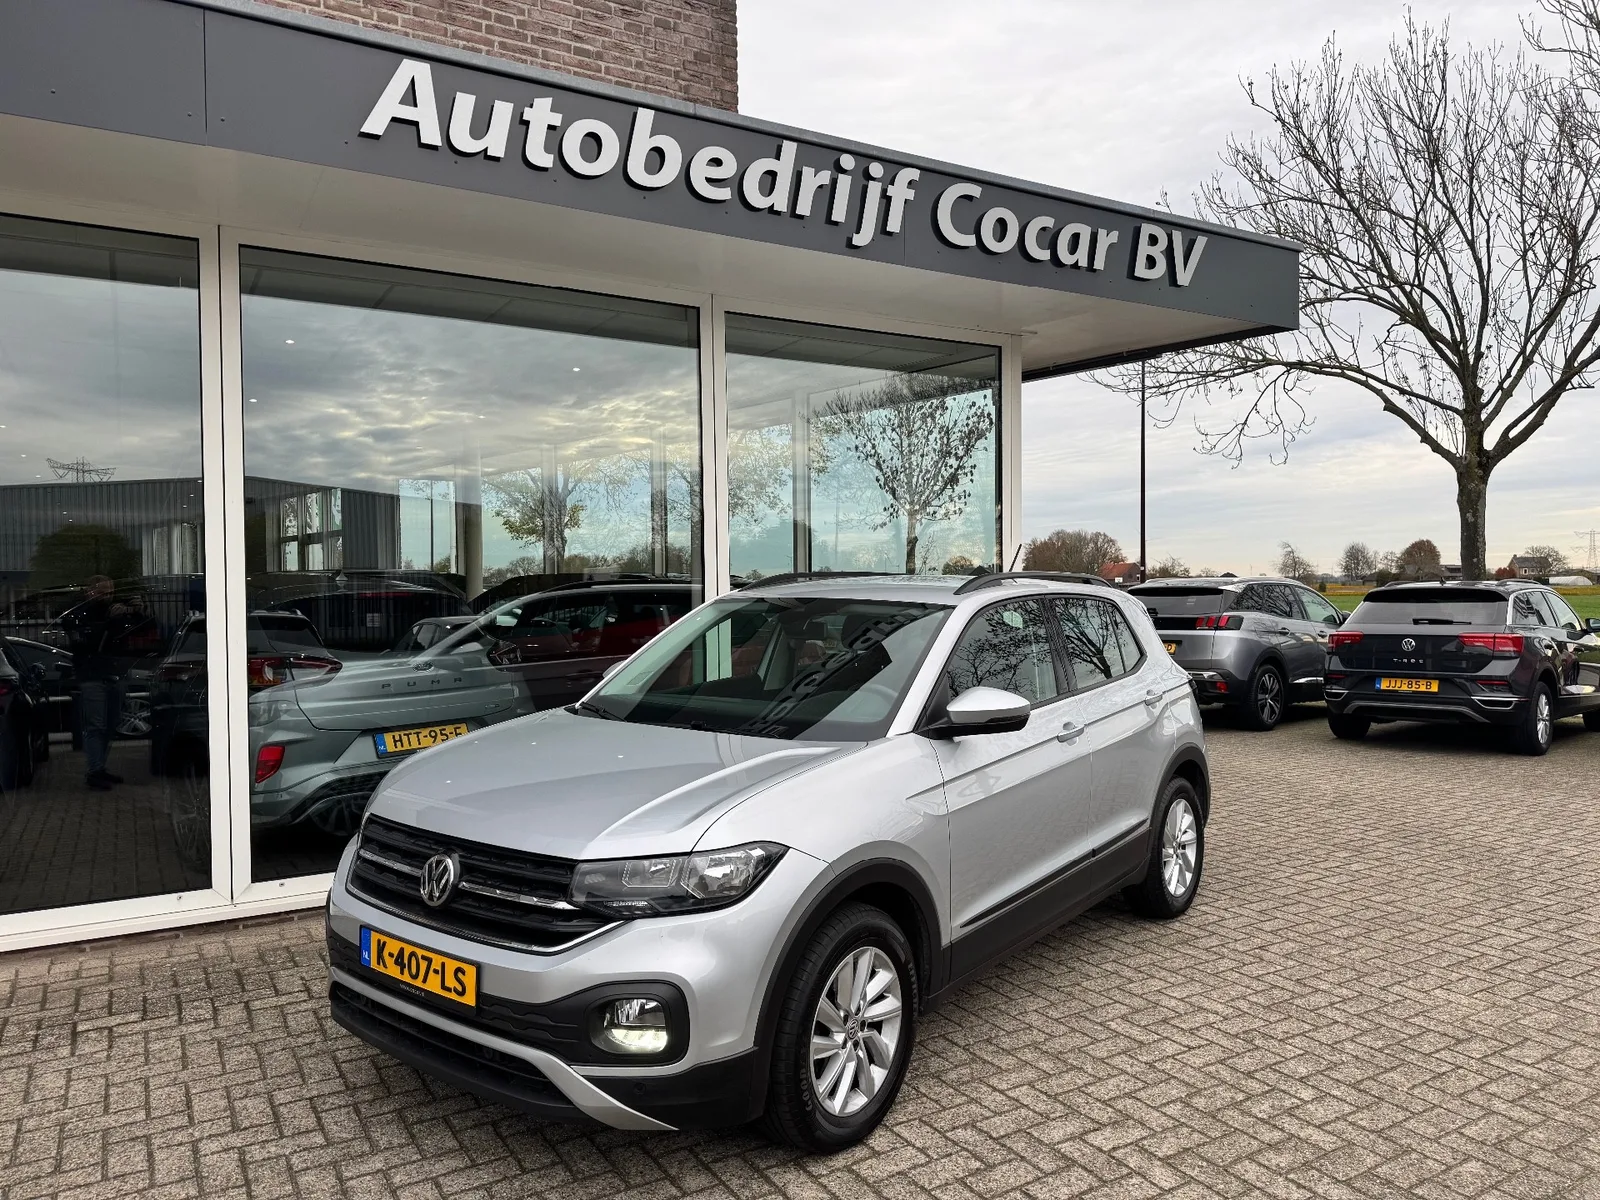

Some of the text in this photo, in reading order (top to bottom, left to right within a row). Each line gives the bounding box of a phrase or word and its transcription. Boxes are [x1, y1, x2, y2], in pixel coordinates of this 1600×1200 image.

[358, 58, 1208, 287] Autobedrijf Cocar BV
[381, 677, 463, 689] PUMA
[1386, 679, 1432, 690] JJJ-85-B
[376, 938, 467, 997] K-407-LS
